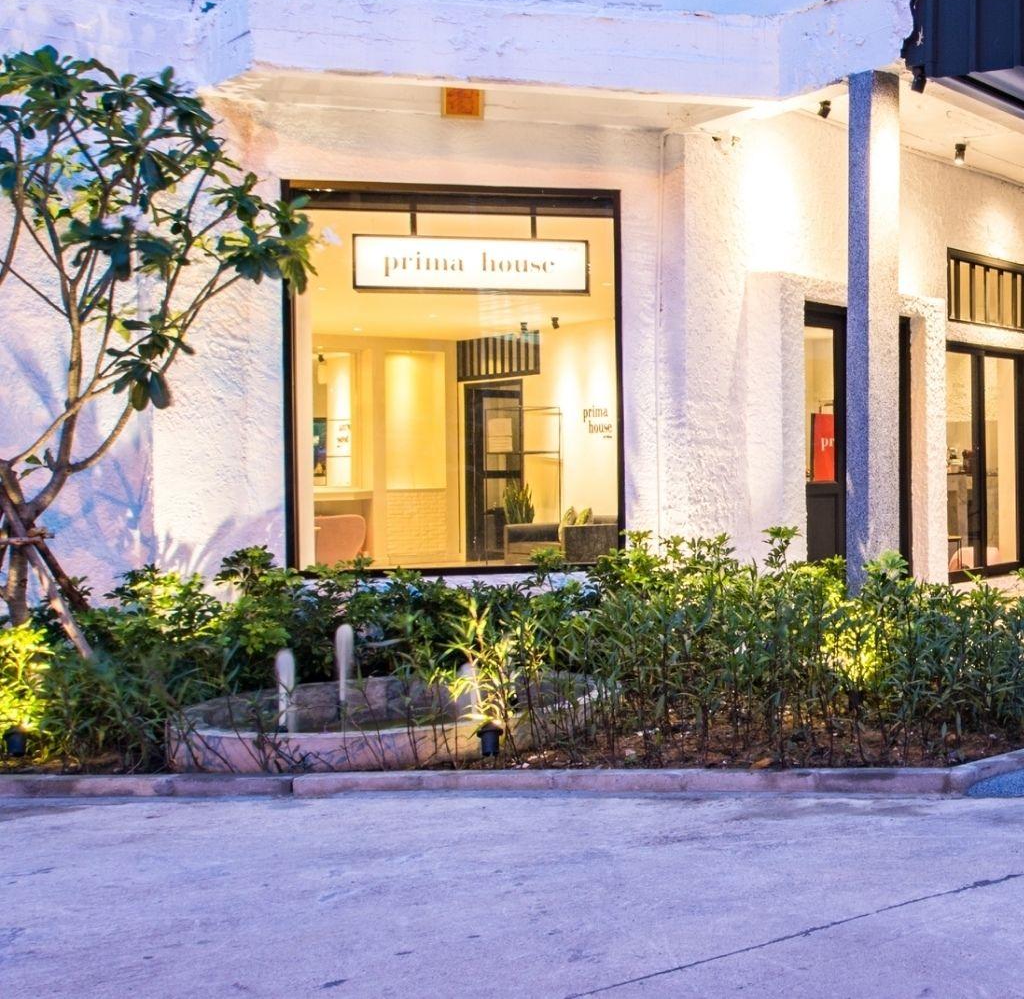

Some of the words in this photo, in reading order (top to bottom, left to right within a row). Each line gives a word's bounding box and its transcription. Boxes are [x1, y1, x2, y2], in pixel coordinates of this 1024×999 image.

[383, 250, 465, 278] prima
[481, 250, 557, 275] house
[583, 404, 609, 423] prima
[588, 420, 613, 434] house
